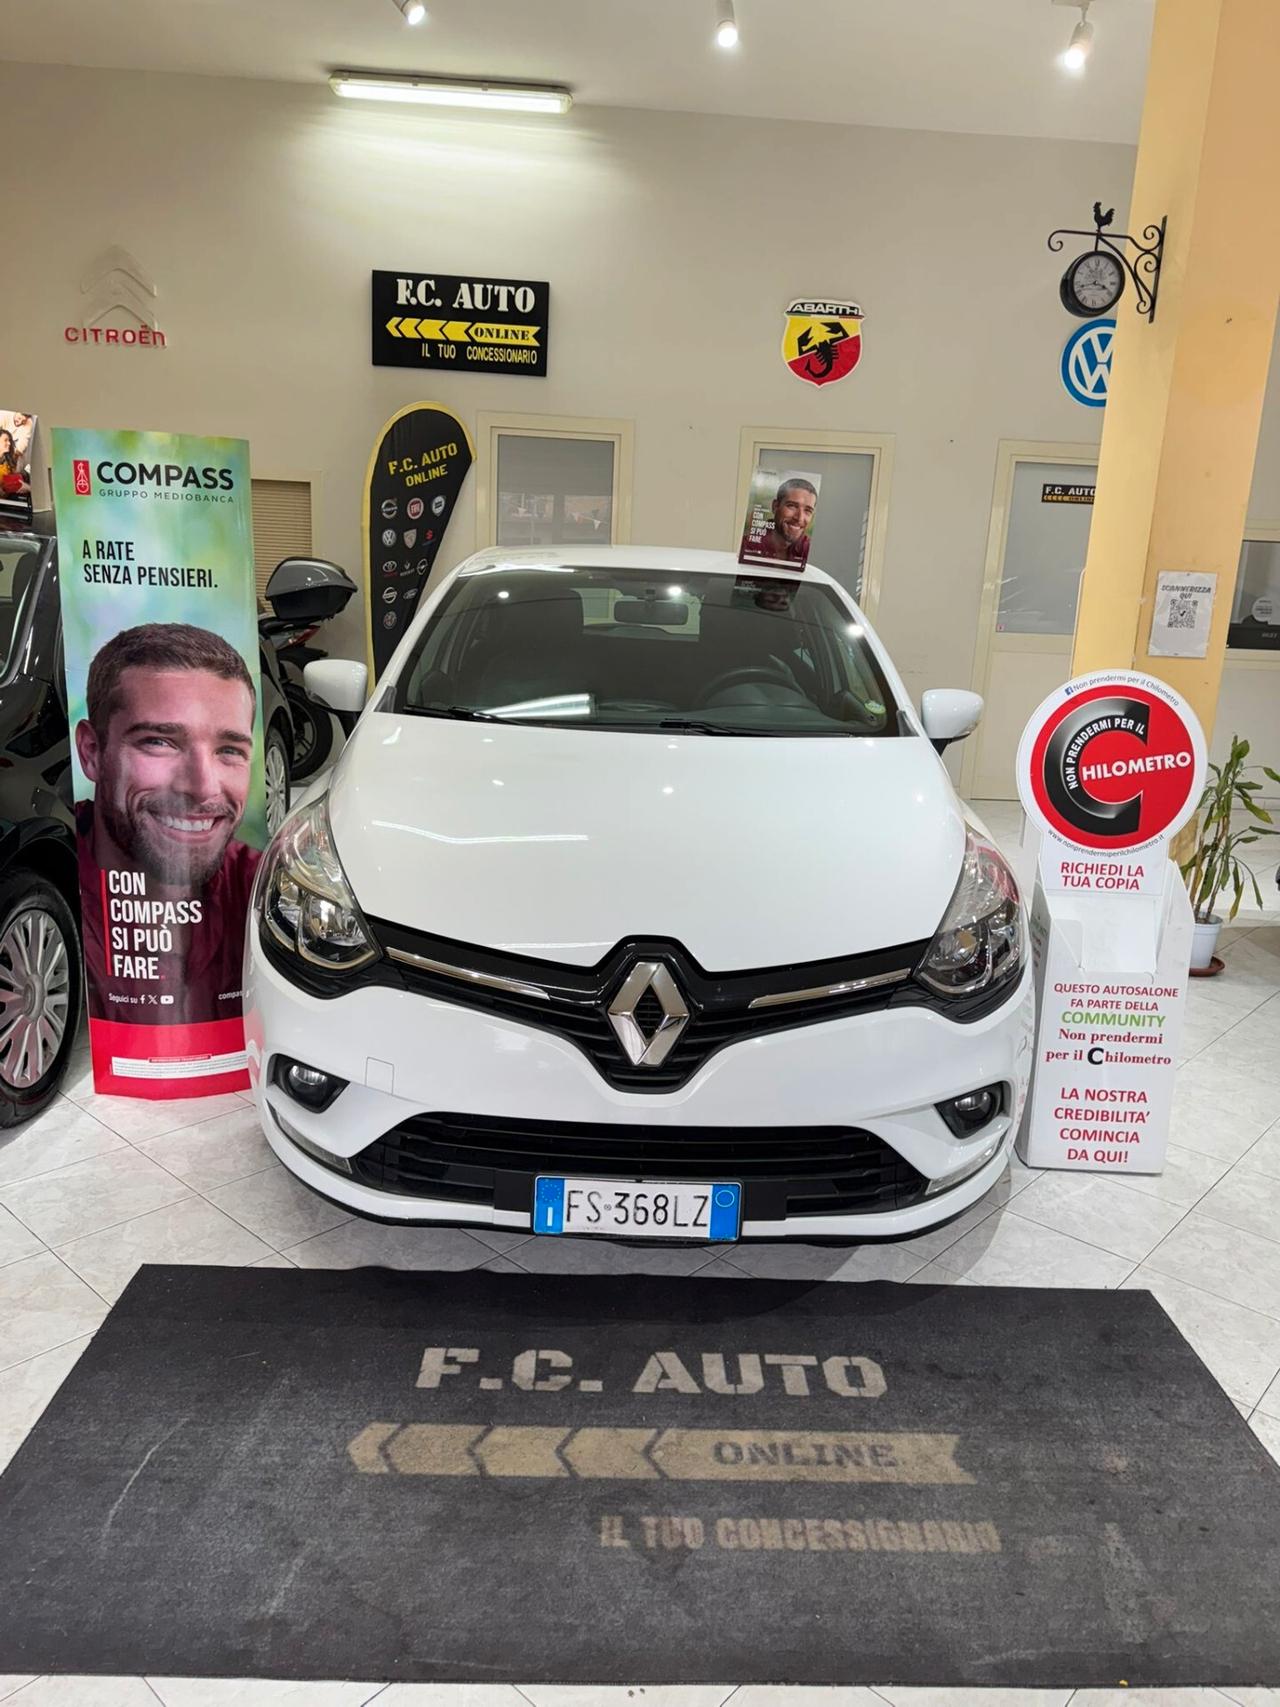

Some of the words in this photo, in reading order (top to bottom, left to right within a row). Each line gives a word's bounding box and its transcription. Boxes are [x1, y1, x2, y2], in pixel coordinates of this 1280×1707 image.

[396, 278, 442, 307] F.C.
[452, 282, 535, 313] AUTO
[792, 303, 858, 315] ABARTH
[474, 326, 530, 341] ONLINE
[421, 342, 430, 357] IL
[437, 343, 456, 359] TUO
[466, 345, 537, 364] CONCESSIONARIO
[388, 457, 418, 475] F.C.
[421, 442, 458, 467] AUTO
[96, 461, 234, 490] COMPASS
[405, 463, 448, 487] ONLINE
[99, 489, 148, 499] GRUPPO
[154, 491, 234, 504] MEDIOBANCA
[1045, 486, 1065, 495] F.C.
[82, 539, 91, 559] A
[95, 540, 135, 561] RATE
[84, 563, 132, 585] SENZA
[137, 566, 218, 588] PENSIERI.
[1073, 681, 1088, 691] Non
[1089, 675, 1126, 686] prendermi
[1146, 680, 1179, 706] Chilometro
[1114, 718, 1135, 730] PER
[1135, 722, 1145, 735] IL
[1066, 719, 1111, 764] PRENDERMI
[1065, 767, 1079, 790] NON
[1061, 861, 1123, 876] RICHIEDI
[1127, 865, 1144, 877] LA
[109, 870, 146, 896] CON
[1062, 875, 1091, 888] TUA
[1095, 877, 1140, 890] COPIA
[110, 898, 203, 924] COMPASS
[111, 926, 129, 950] SI
[133, 923, 172, 952] PUÒ
[109, 993, 129, 1003] Seguici
[130, 996, 138, 1004] su
[1054, 983, 1100, 995] QUESTO
[1102, 985, 1179, 998] AUTOSALONE
[1070, 998, 1084, 1008] FA
[1087, 999, 1122, 1010] PARTE
[1125, 1001, 1159, 1011] DELLA
[1061, 1011, 1166, 1027] COMMUNITY
[1059, 1028, 1086, 1040] Non
[1090, 1032, 1163, 1044] prendermi
[1046, 1050, 1069, 1062] per
[1073, 1050, 1083, 1061] il
[1087, 1047, 1172, 1065] Chilometro
[1061, 1087, 1079, 1100] LA
[1084, 1088, 1148, 1103] NOSTRA
[1060, 1128, 1140, 1143] COMINCIA
[1067, 1148, 1089, 1161] DA
[1094, 1150, 1129, 1163] QUI!
[415, 1347, 604, 1391] F.C.
[632, 1351, 888, 1398] AUTO
[713, 1440, 898, 1467] ONLINE
[639, 1516, 705, 1549] TUO
